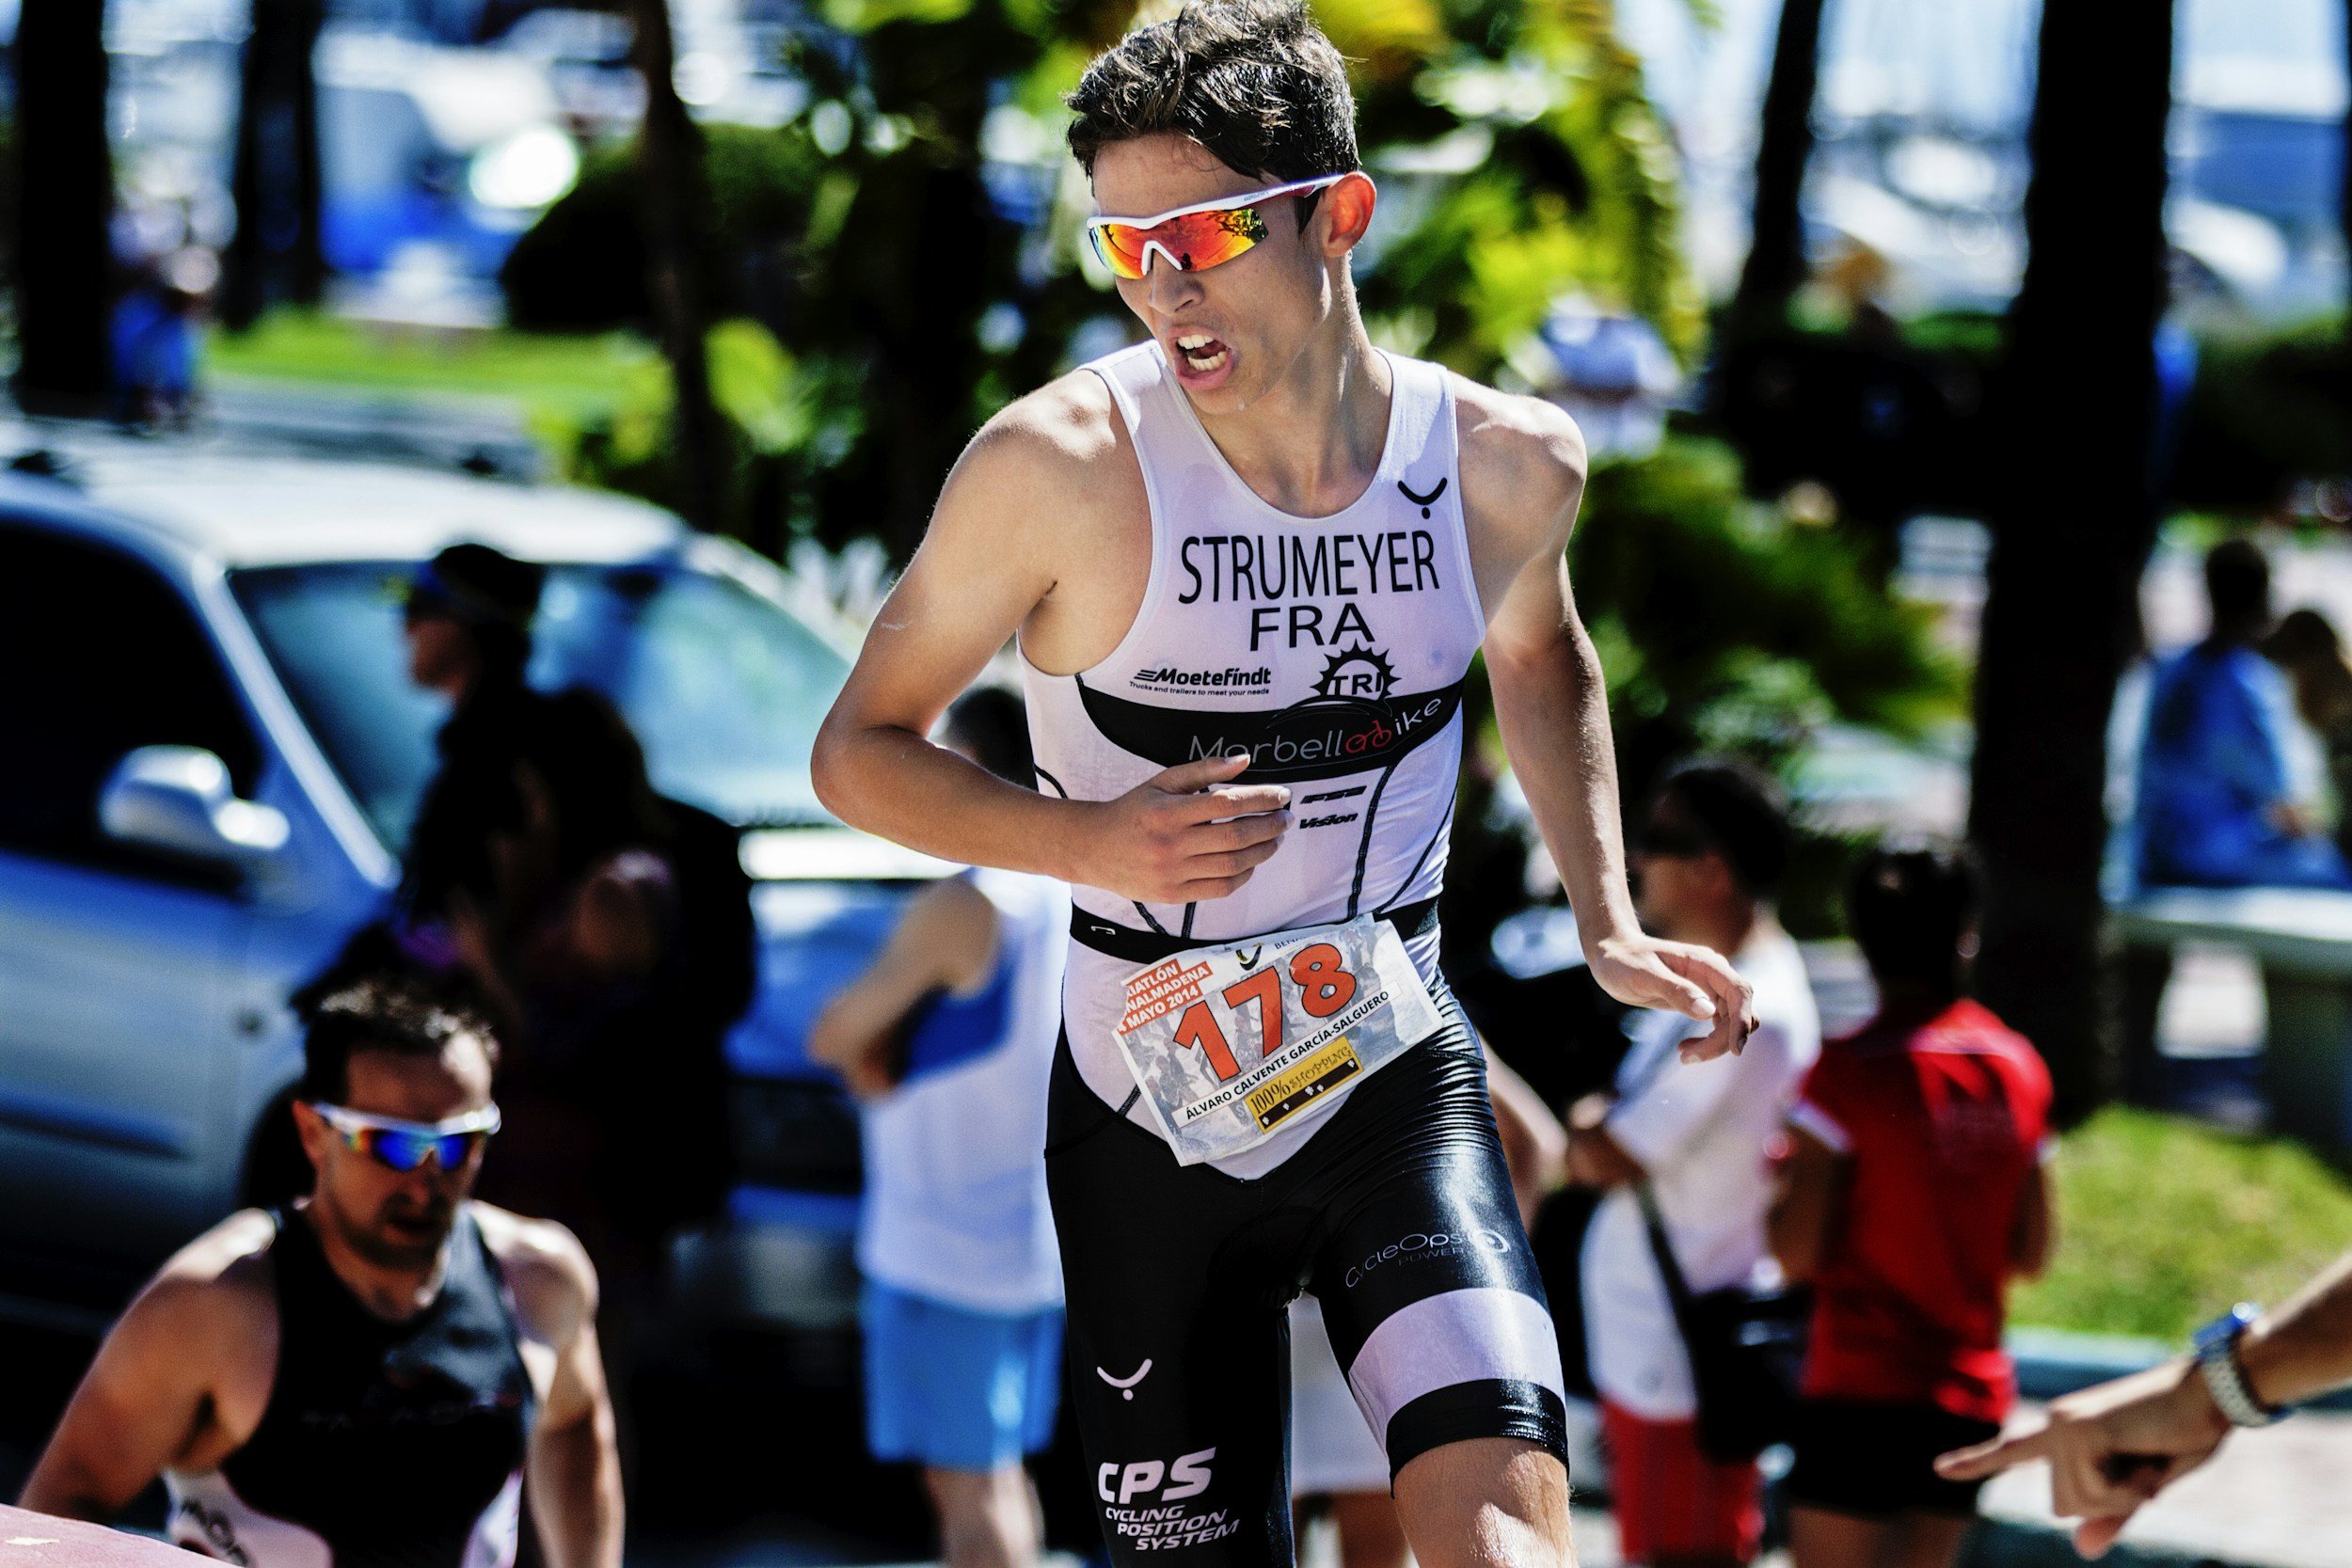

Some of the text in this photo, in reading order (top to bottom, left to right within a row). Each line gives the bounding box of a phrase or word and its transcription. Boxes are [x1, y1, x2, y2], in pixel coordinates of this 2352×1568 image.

[1178, 530, 1439, 604] STRUMEYER
[1250, 603, 1375, 652] FRA
[1129, 681, 1152, 691] Trucks
[1169, 687, 1197, 695] trailers
[1228, 689, 1246, 697] your
[1247, 688, 1270, 696] needs
[1152, 666, 1271, 686] Moetefindt
[1331, 672, 1381, 696] TRI
[1299, 813, 1359, 829] Vision
[1125, 984, 1200, 1029] MAYO 2014
[1172, 942, 1358, 1083] 178
[1185, 1090, 1232, 1120] ÁLVARO
[1233, 1055, 1289, 1096] CALVENTE
[1289, 990, 1390, 1059] GARCÍA-SALGUERO
[1097, 1446, 1216, 1505] CPS
[1104, 1504, 1186, 1523] CYCLING
[1117, 1508, 1228, 1537] POSITION
[1135, 1518, 1241, 1551] SYSTEM
